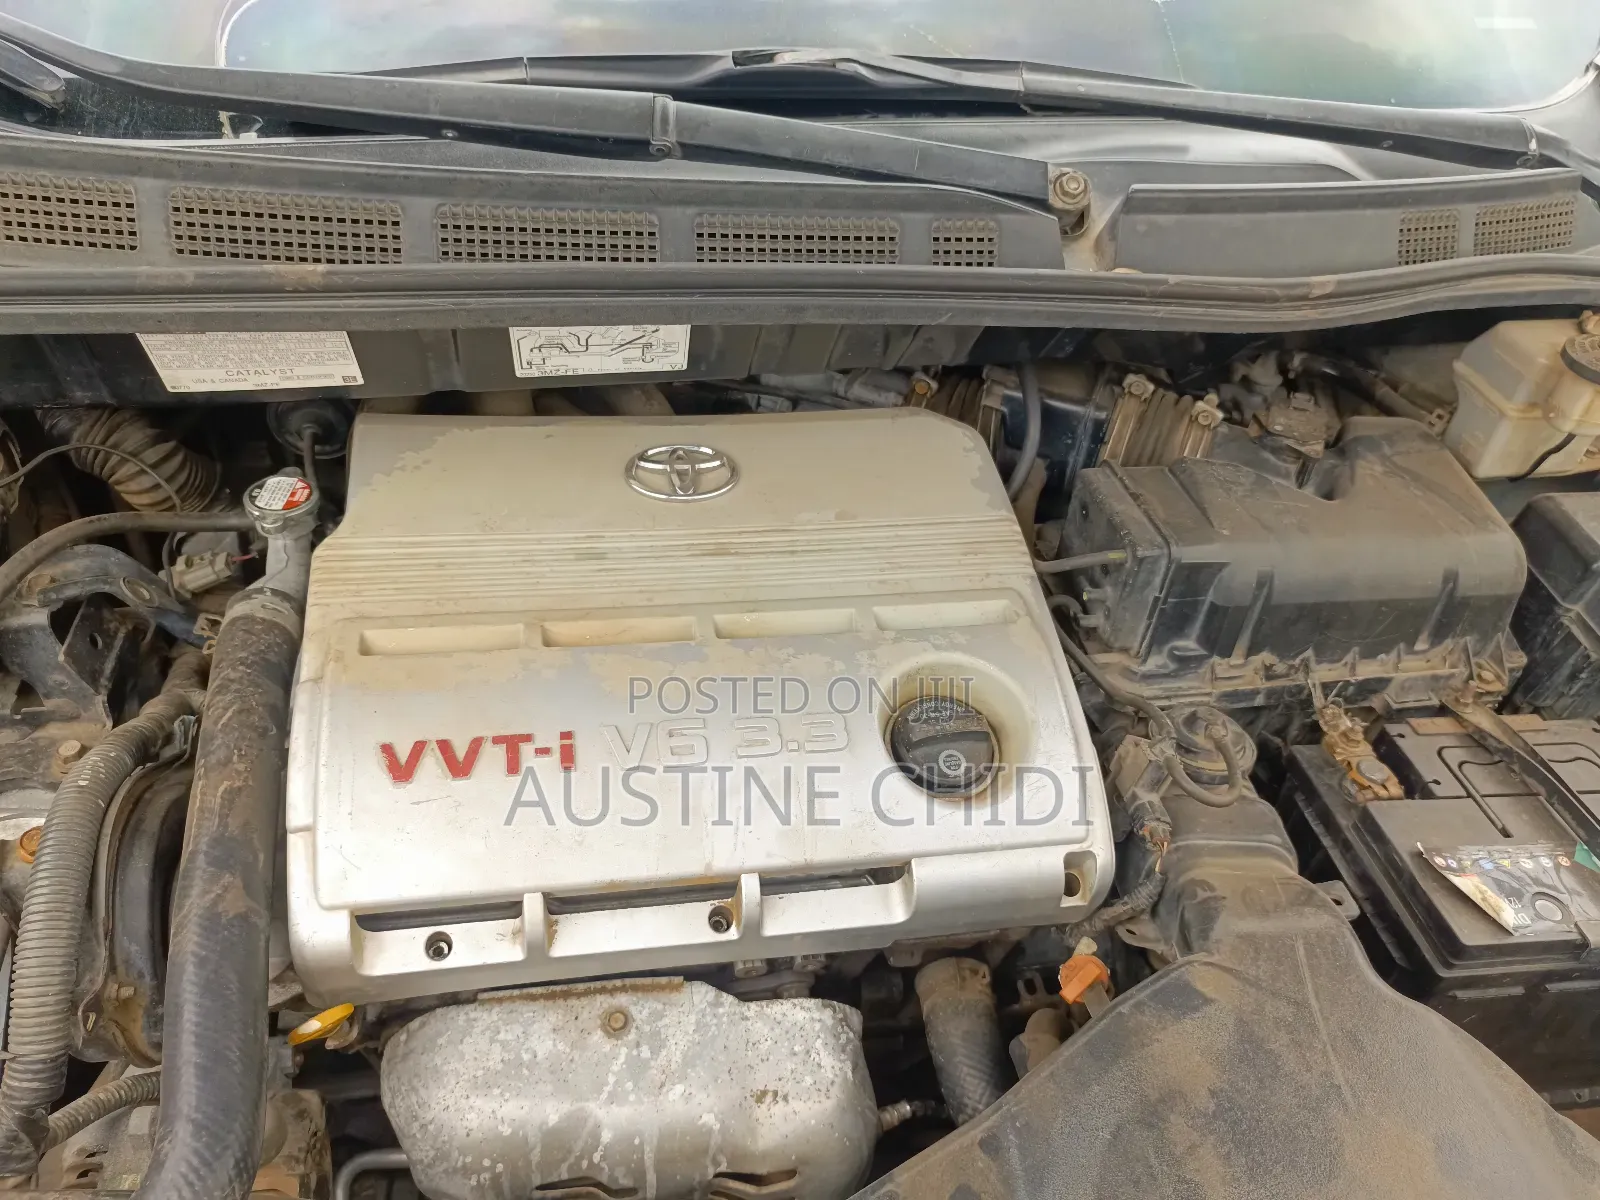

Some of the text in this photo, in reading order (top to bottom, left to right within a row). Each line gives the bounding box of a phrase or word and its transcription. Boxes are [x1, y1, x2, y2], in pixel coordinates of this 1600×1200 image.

[225, 368, 295, 377] CATALYST
[537, 368, 580, 376] 3MZ-FE
[379, 712, 850, 788] VVT-i V6 3.3
